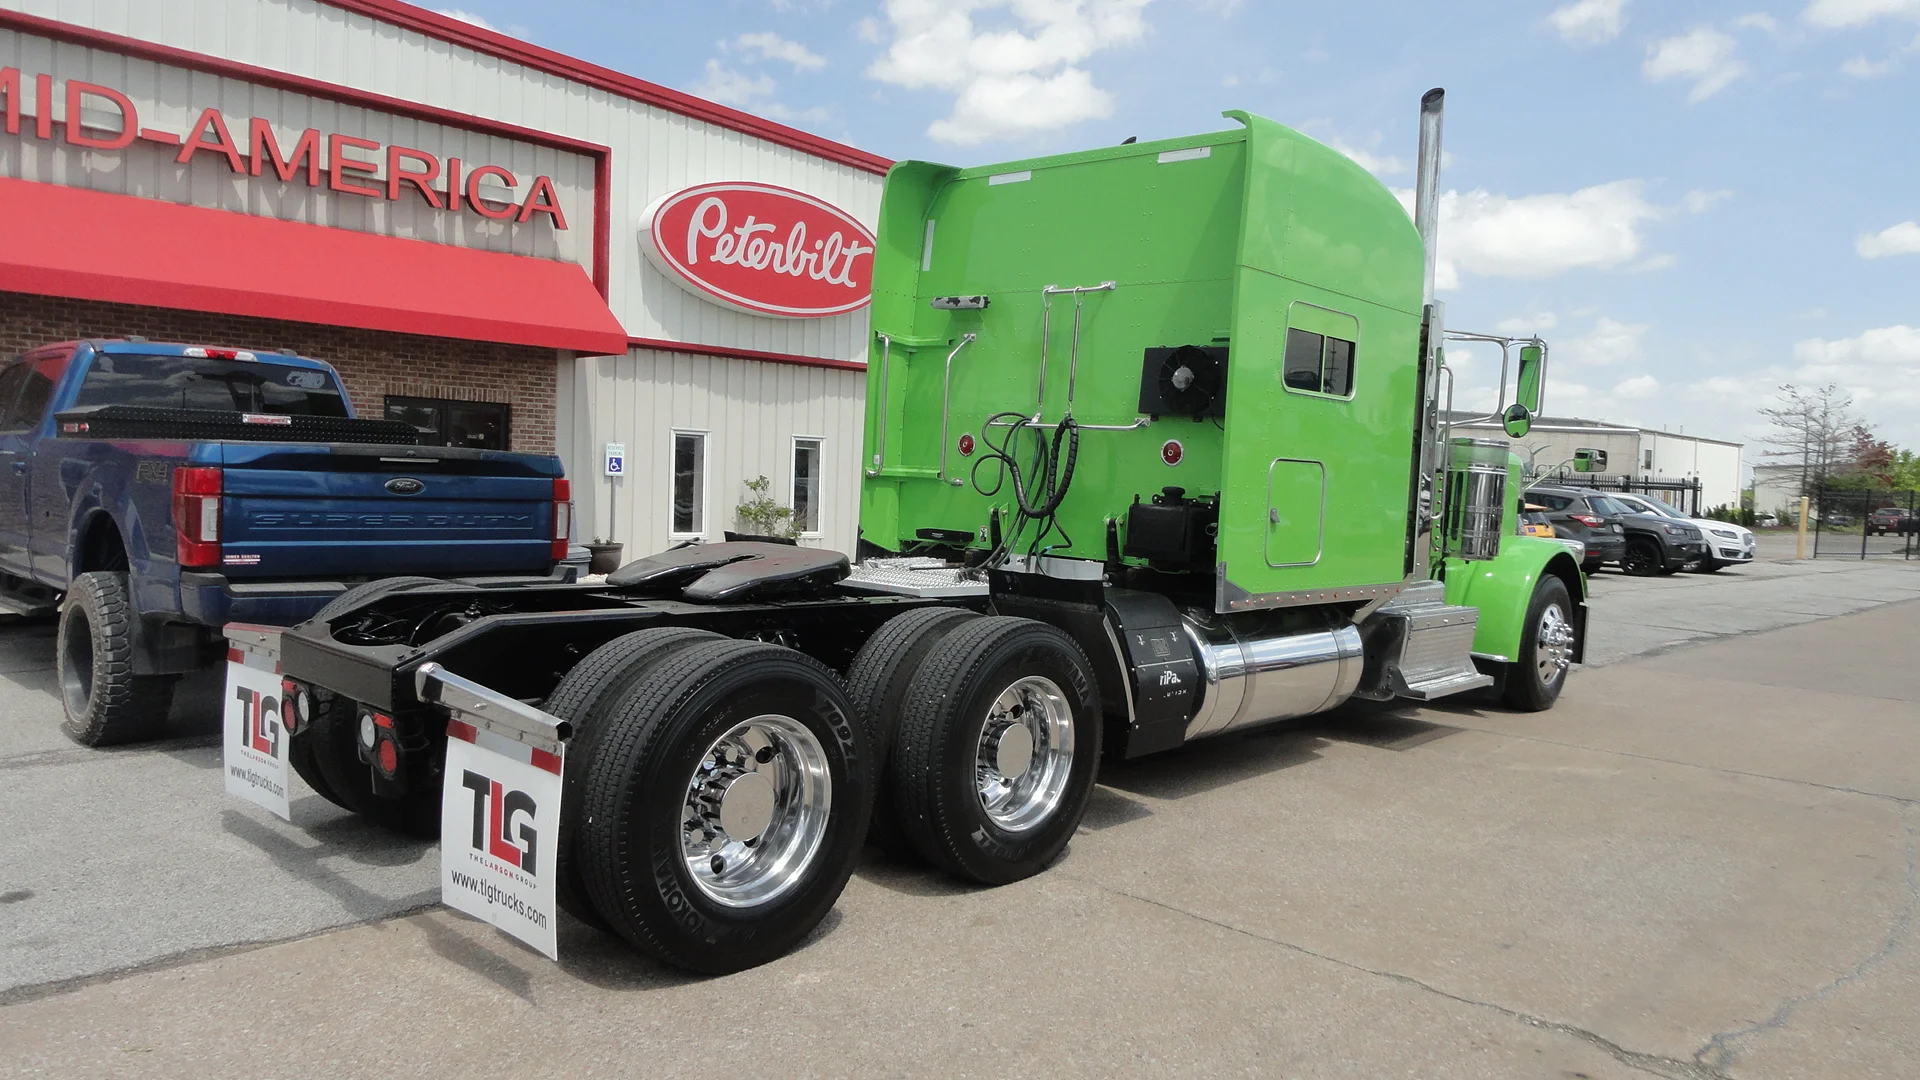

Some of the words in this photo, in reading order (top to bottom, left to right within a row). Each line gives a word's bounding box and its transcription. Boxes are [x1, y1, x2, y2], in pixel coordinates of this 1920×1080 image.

[687, 196, 874, 288] Peterbilt
[136, 460, 170, 484] FX4
[255, 514, 414, 526] SUPER
[427, 514, 530, 526] DUTY
[237, 685, 279, 760] TLG
[230, 764, 285, 799] www.tlgtrucks.com
[462, 768, 538, 878] TLG
[451, 869, 547, 930] www.tlgtrucks.com
[515, 873, 538, 889] GROUP
